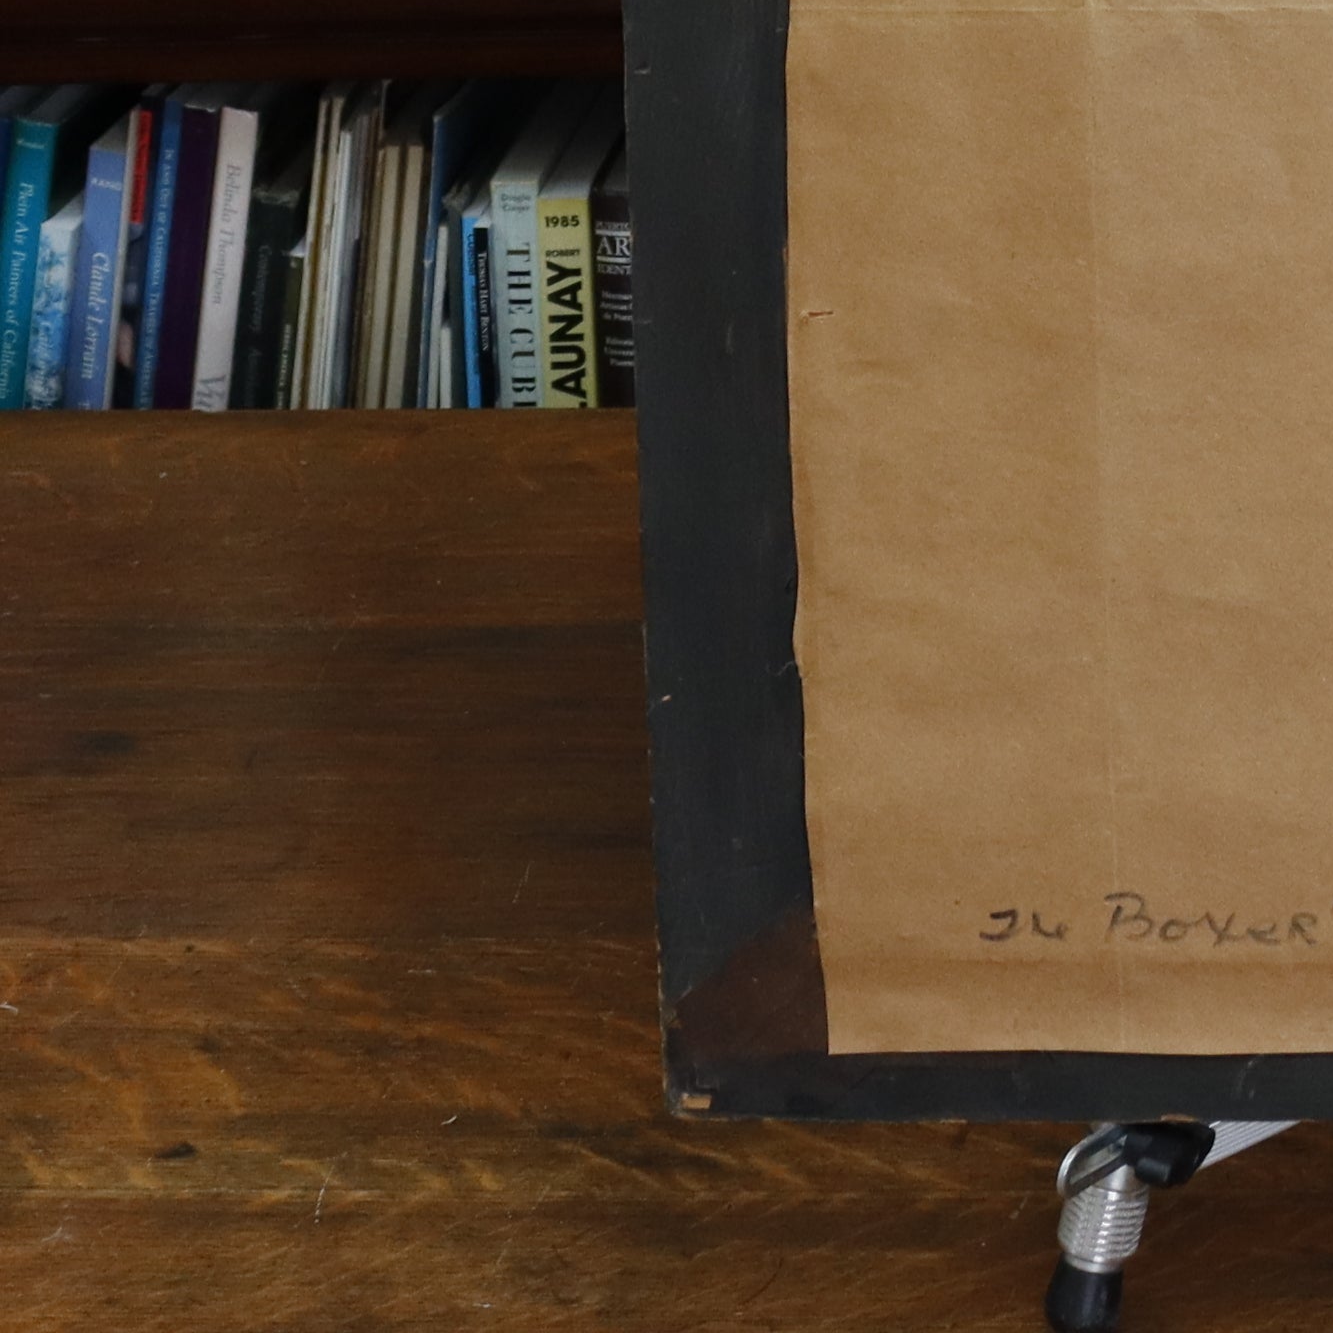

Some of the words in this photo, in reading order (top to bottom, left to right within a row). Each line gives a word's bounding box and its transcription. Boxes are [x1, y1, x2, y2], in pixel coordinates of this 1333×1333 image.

[19, 181, 35, 218] Plein
[221, 164, 242, 223] Belinda
[15, 221, 31, 245] Air
[544, 214, 581, 228] 1985
[9, 249, 27, 305] Painters
[210, 229, 235, 305] Thompson
[477, 250, 489, 288] THOMAS
[545, 249, 581, 258] ROBERT
[87, 251, 110, 311] Claude
[479, 289, 490, 313] HART
[505, 242, 534, 315] THE
[5, 308, 19, 327] of
[480, 315, 491, 352] BENTON
[545, 260, 588, 408] AUNAY
[0, 328, 17, 400] California
[80, 315, 104, 380] Lorrain
